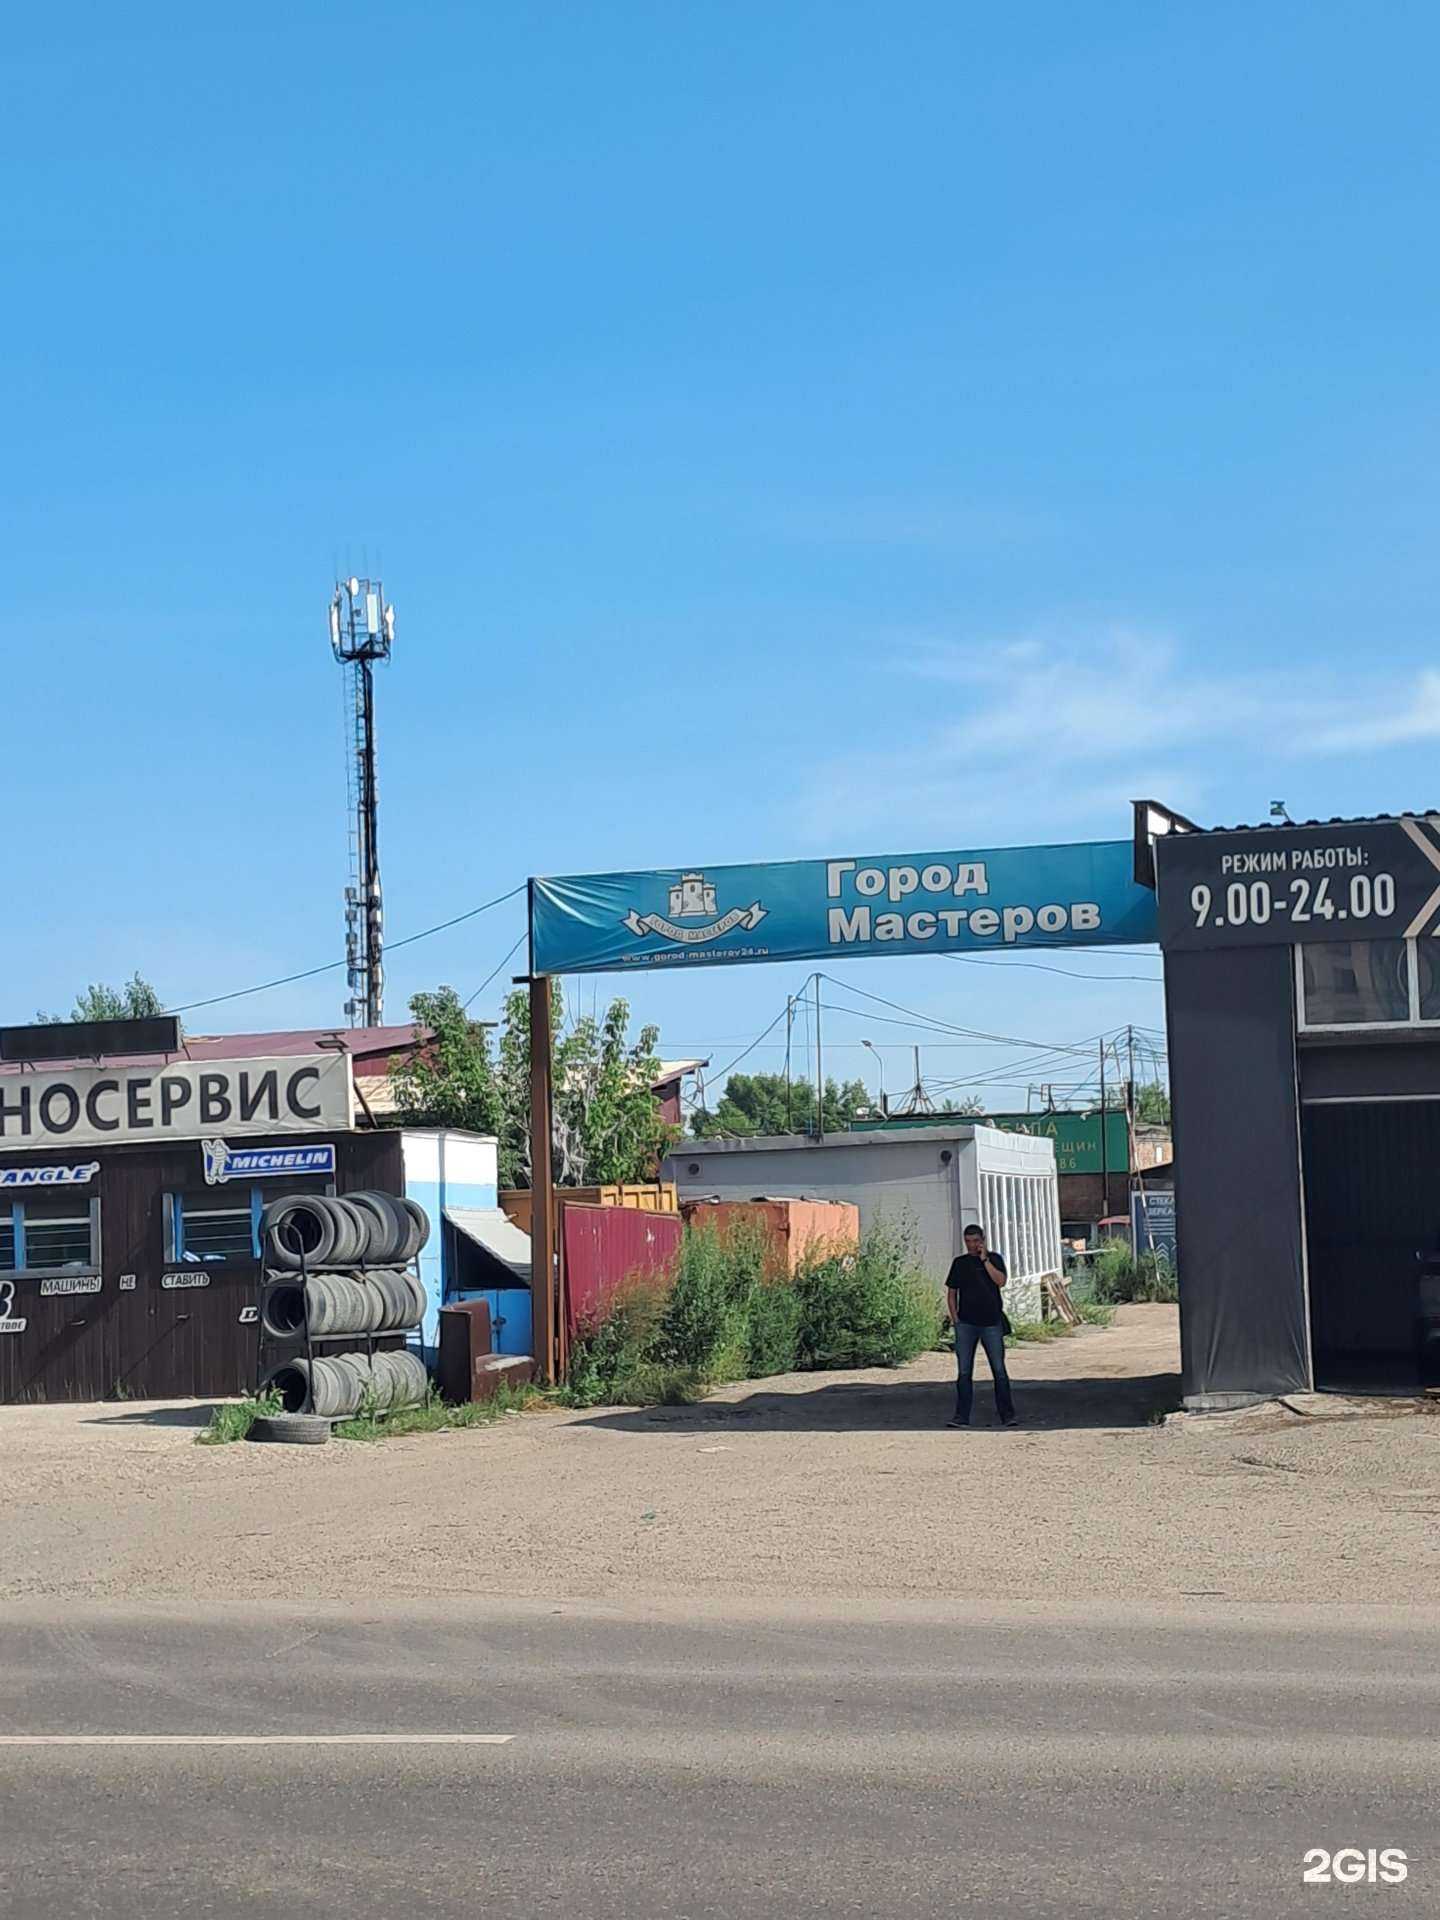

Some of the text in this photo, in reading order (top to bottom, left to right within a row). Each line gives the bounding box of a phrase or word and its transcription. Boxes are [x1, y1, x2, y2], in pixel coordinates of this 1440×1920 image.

[826, 860, 988, 902] Город
[1222, 847, 1369, 875] РЕЖИМ РАБОТЫ:
[1191, 873, 1396, 928] 9.00-24.00
[827, 901, 1101, 943] Мастеров
[0, 1066, 321, 1136] НОСЕРВИС
[231, 1151, 328, 1169] MICHELIN
[41, 1273, 209, 1294] МАШИНЫ НЕ СТАВИТЬ
